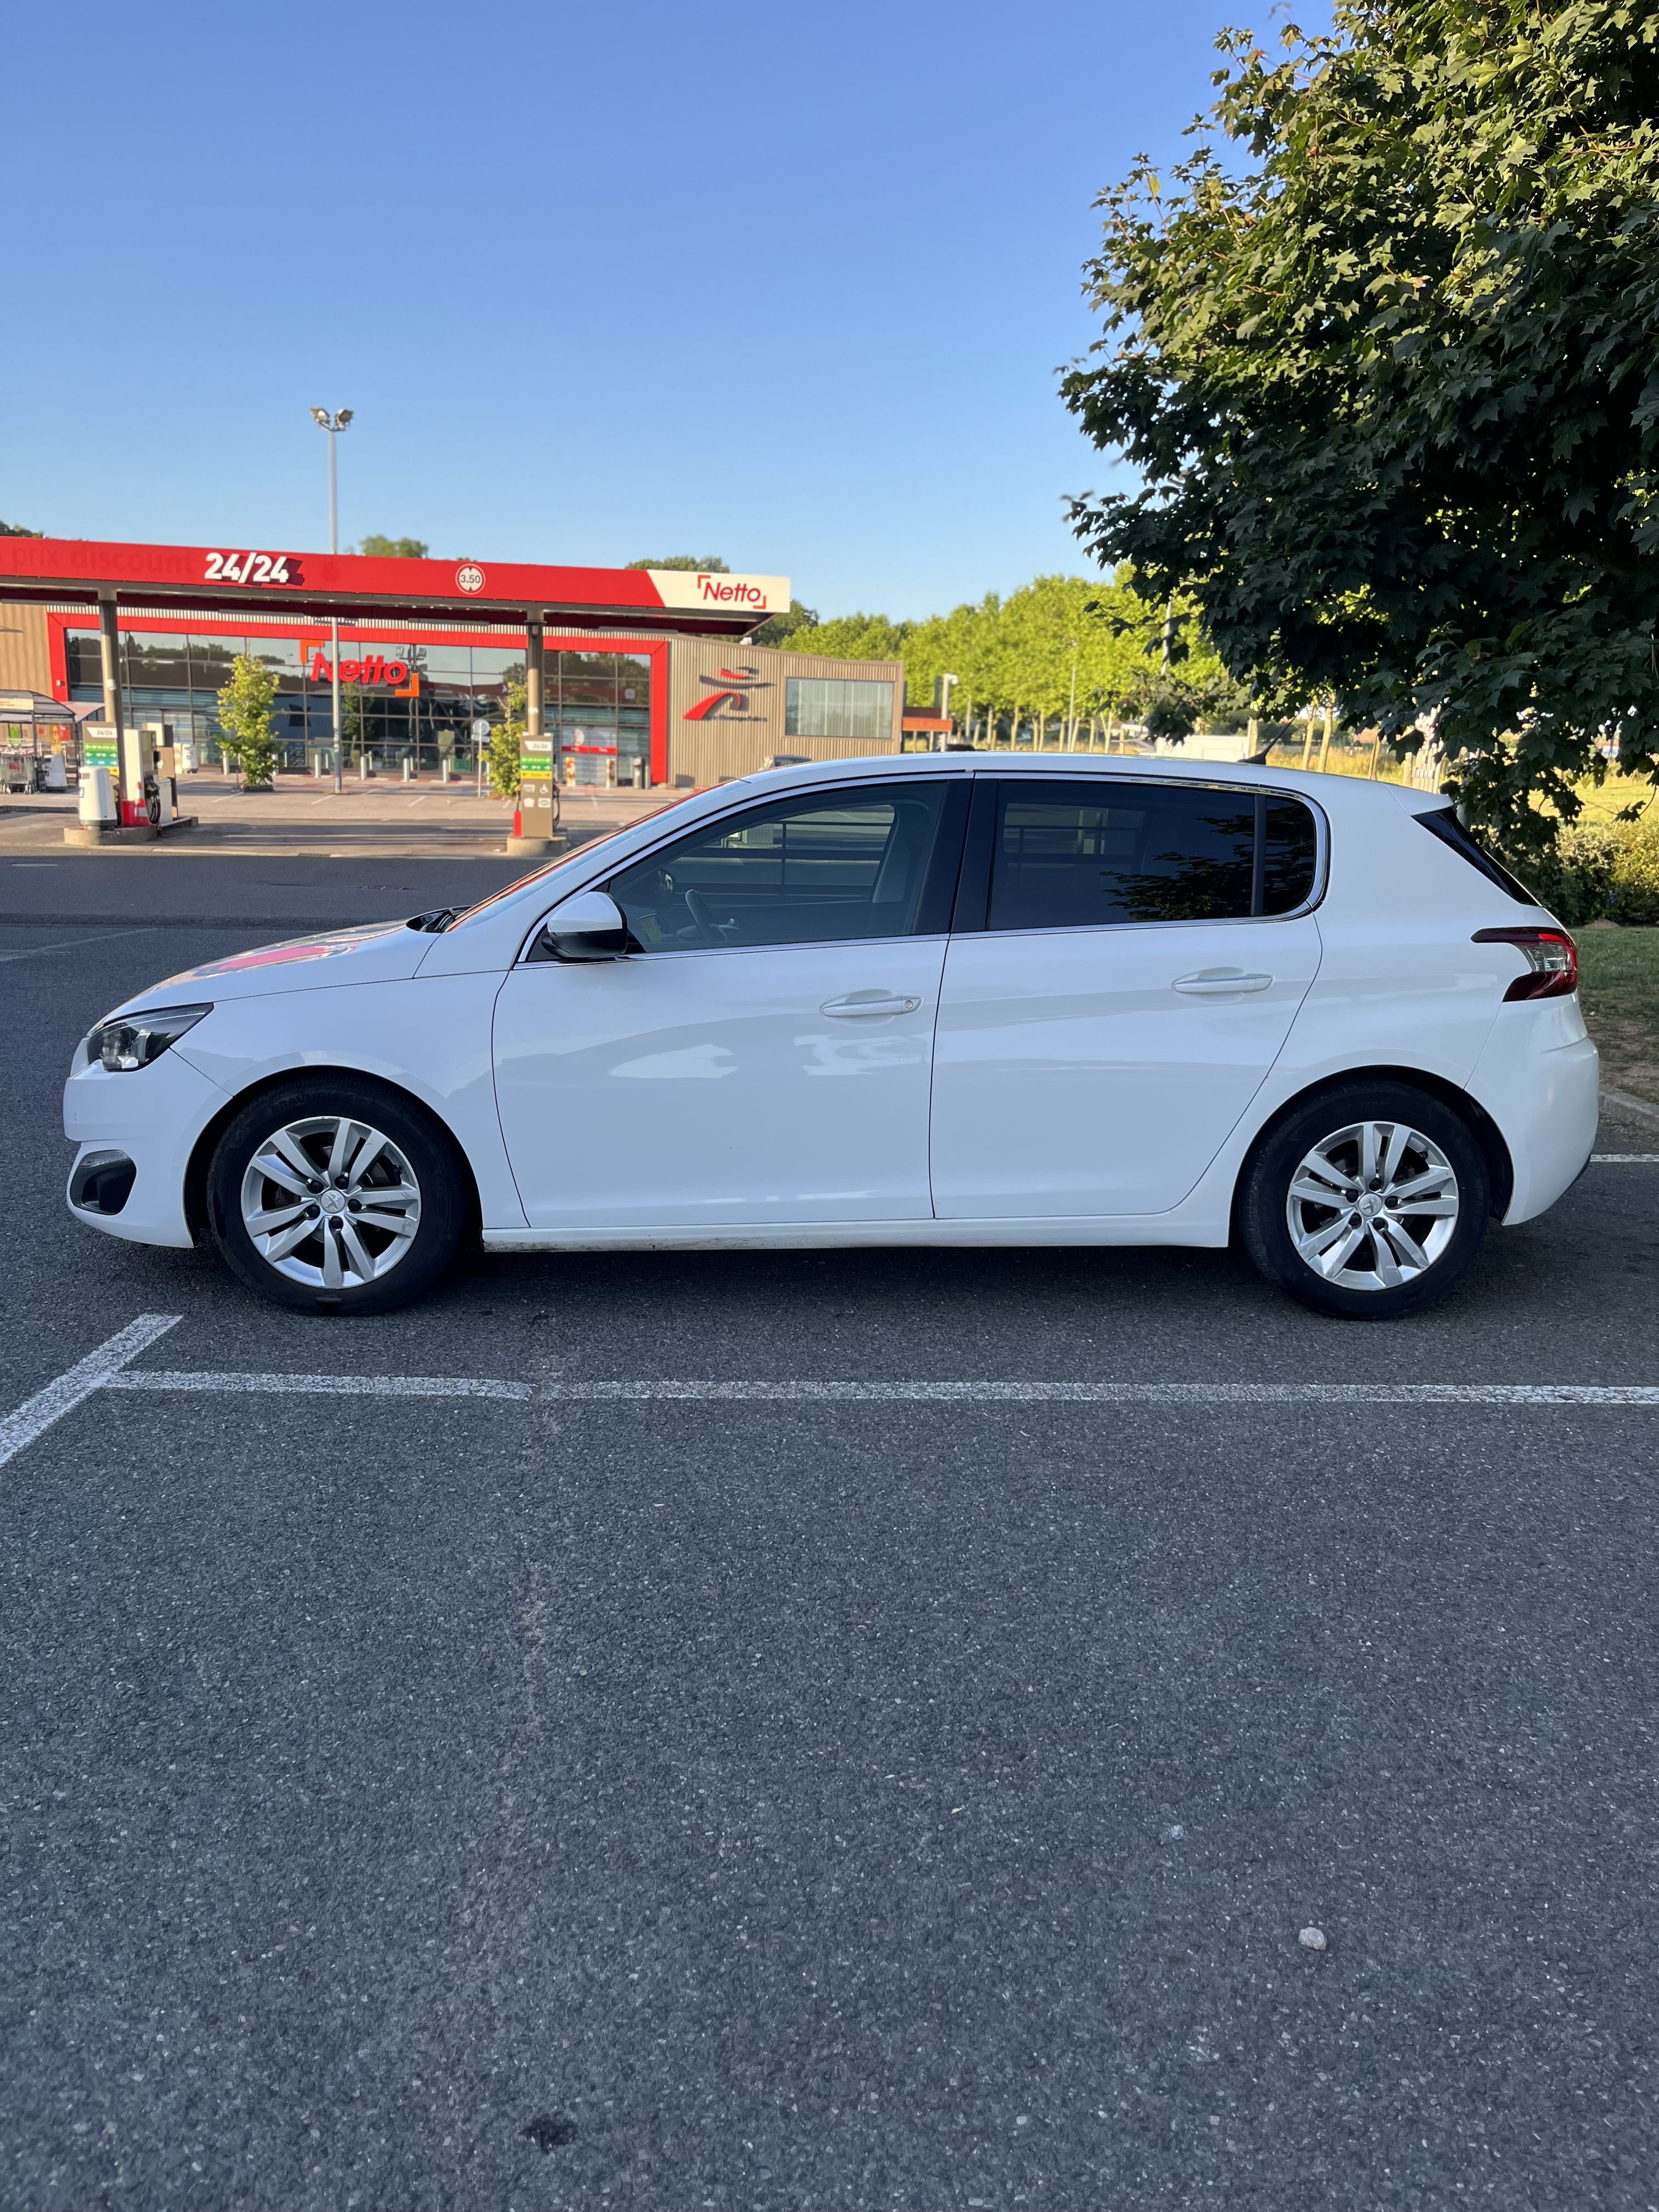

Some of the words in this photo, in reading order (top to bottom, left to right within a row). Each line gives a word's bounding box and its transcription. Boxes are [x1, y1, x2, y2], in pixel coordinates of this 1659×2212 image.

[12, 542, 59, 572] prix
[70, 543, 194, 574] discount
[205, 552, 289, 583] 24/24
[460, 574, 481, 583] 3.50
[703, 582, 761, 602] Netto
[311, 652, 407, 684] Netto
